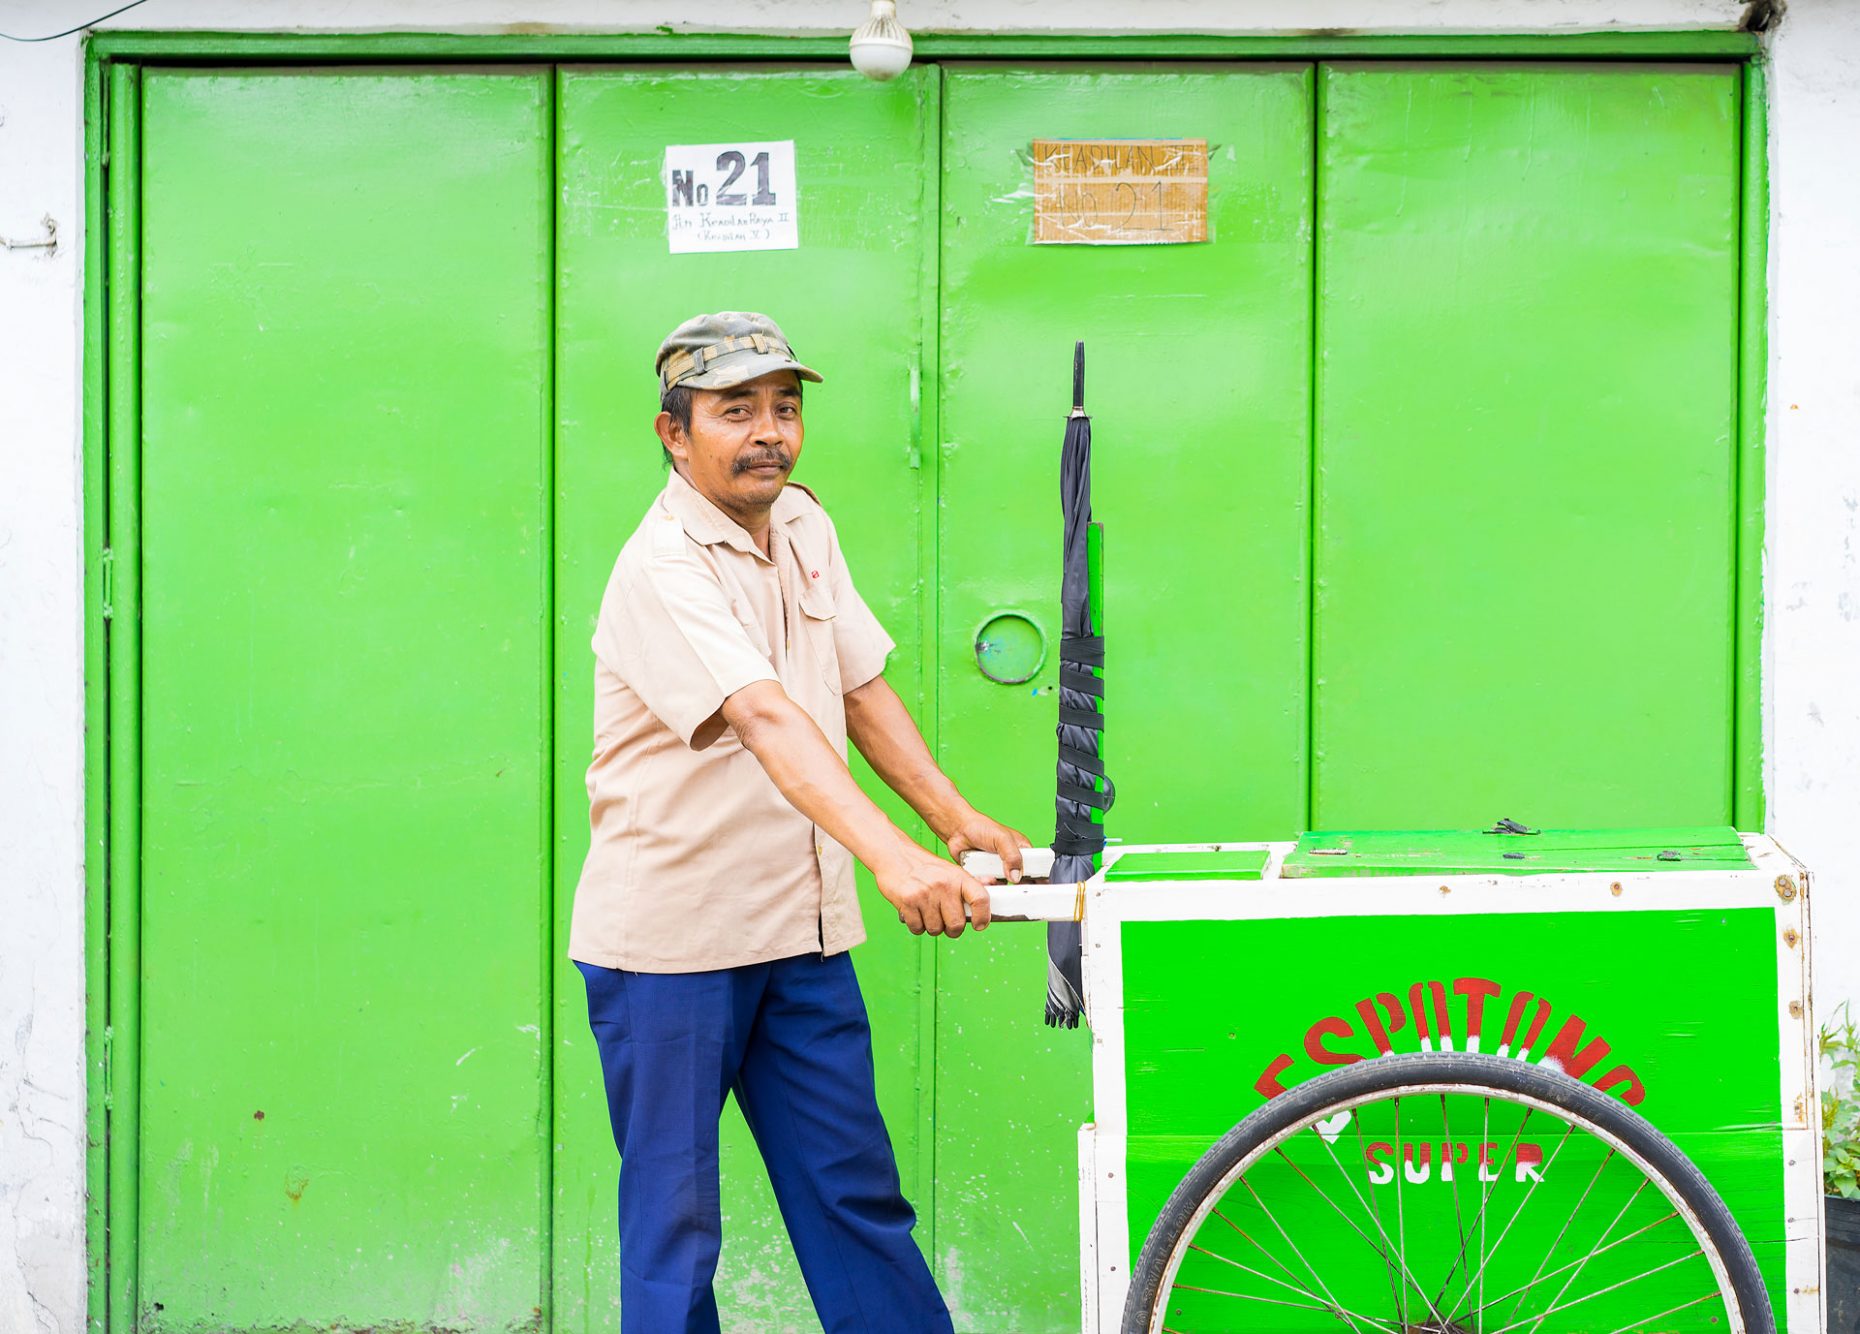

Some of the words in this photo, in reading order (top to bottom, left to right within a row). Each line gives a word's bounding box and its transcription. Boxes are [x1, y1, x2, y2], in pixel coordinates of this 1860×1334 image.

[716, 151, 776, 206] 21
[1114, 181, 1174, 232] 21
[1366, 1142, 1544, 1184] SUPER
